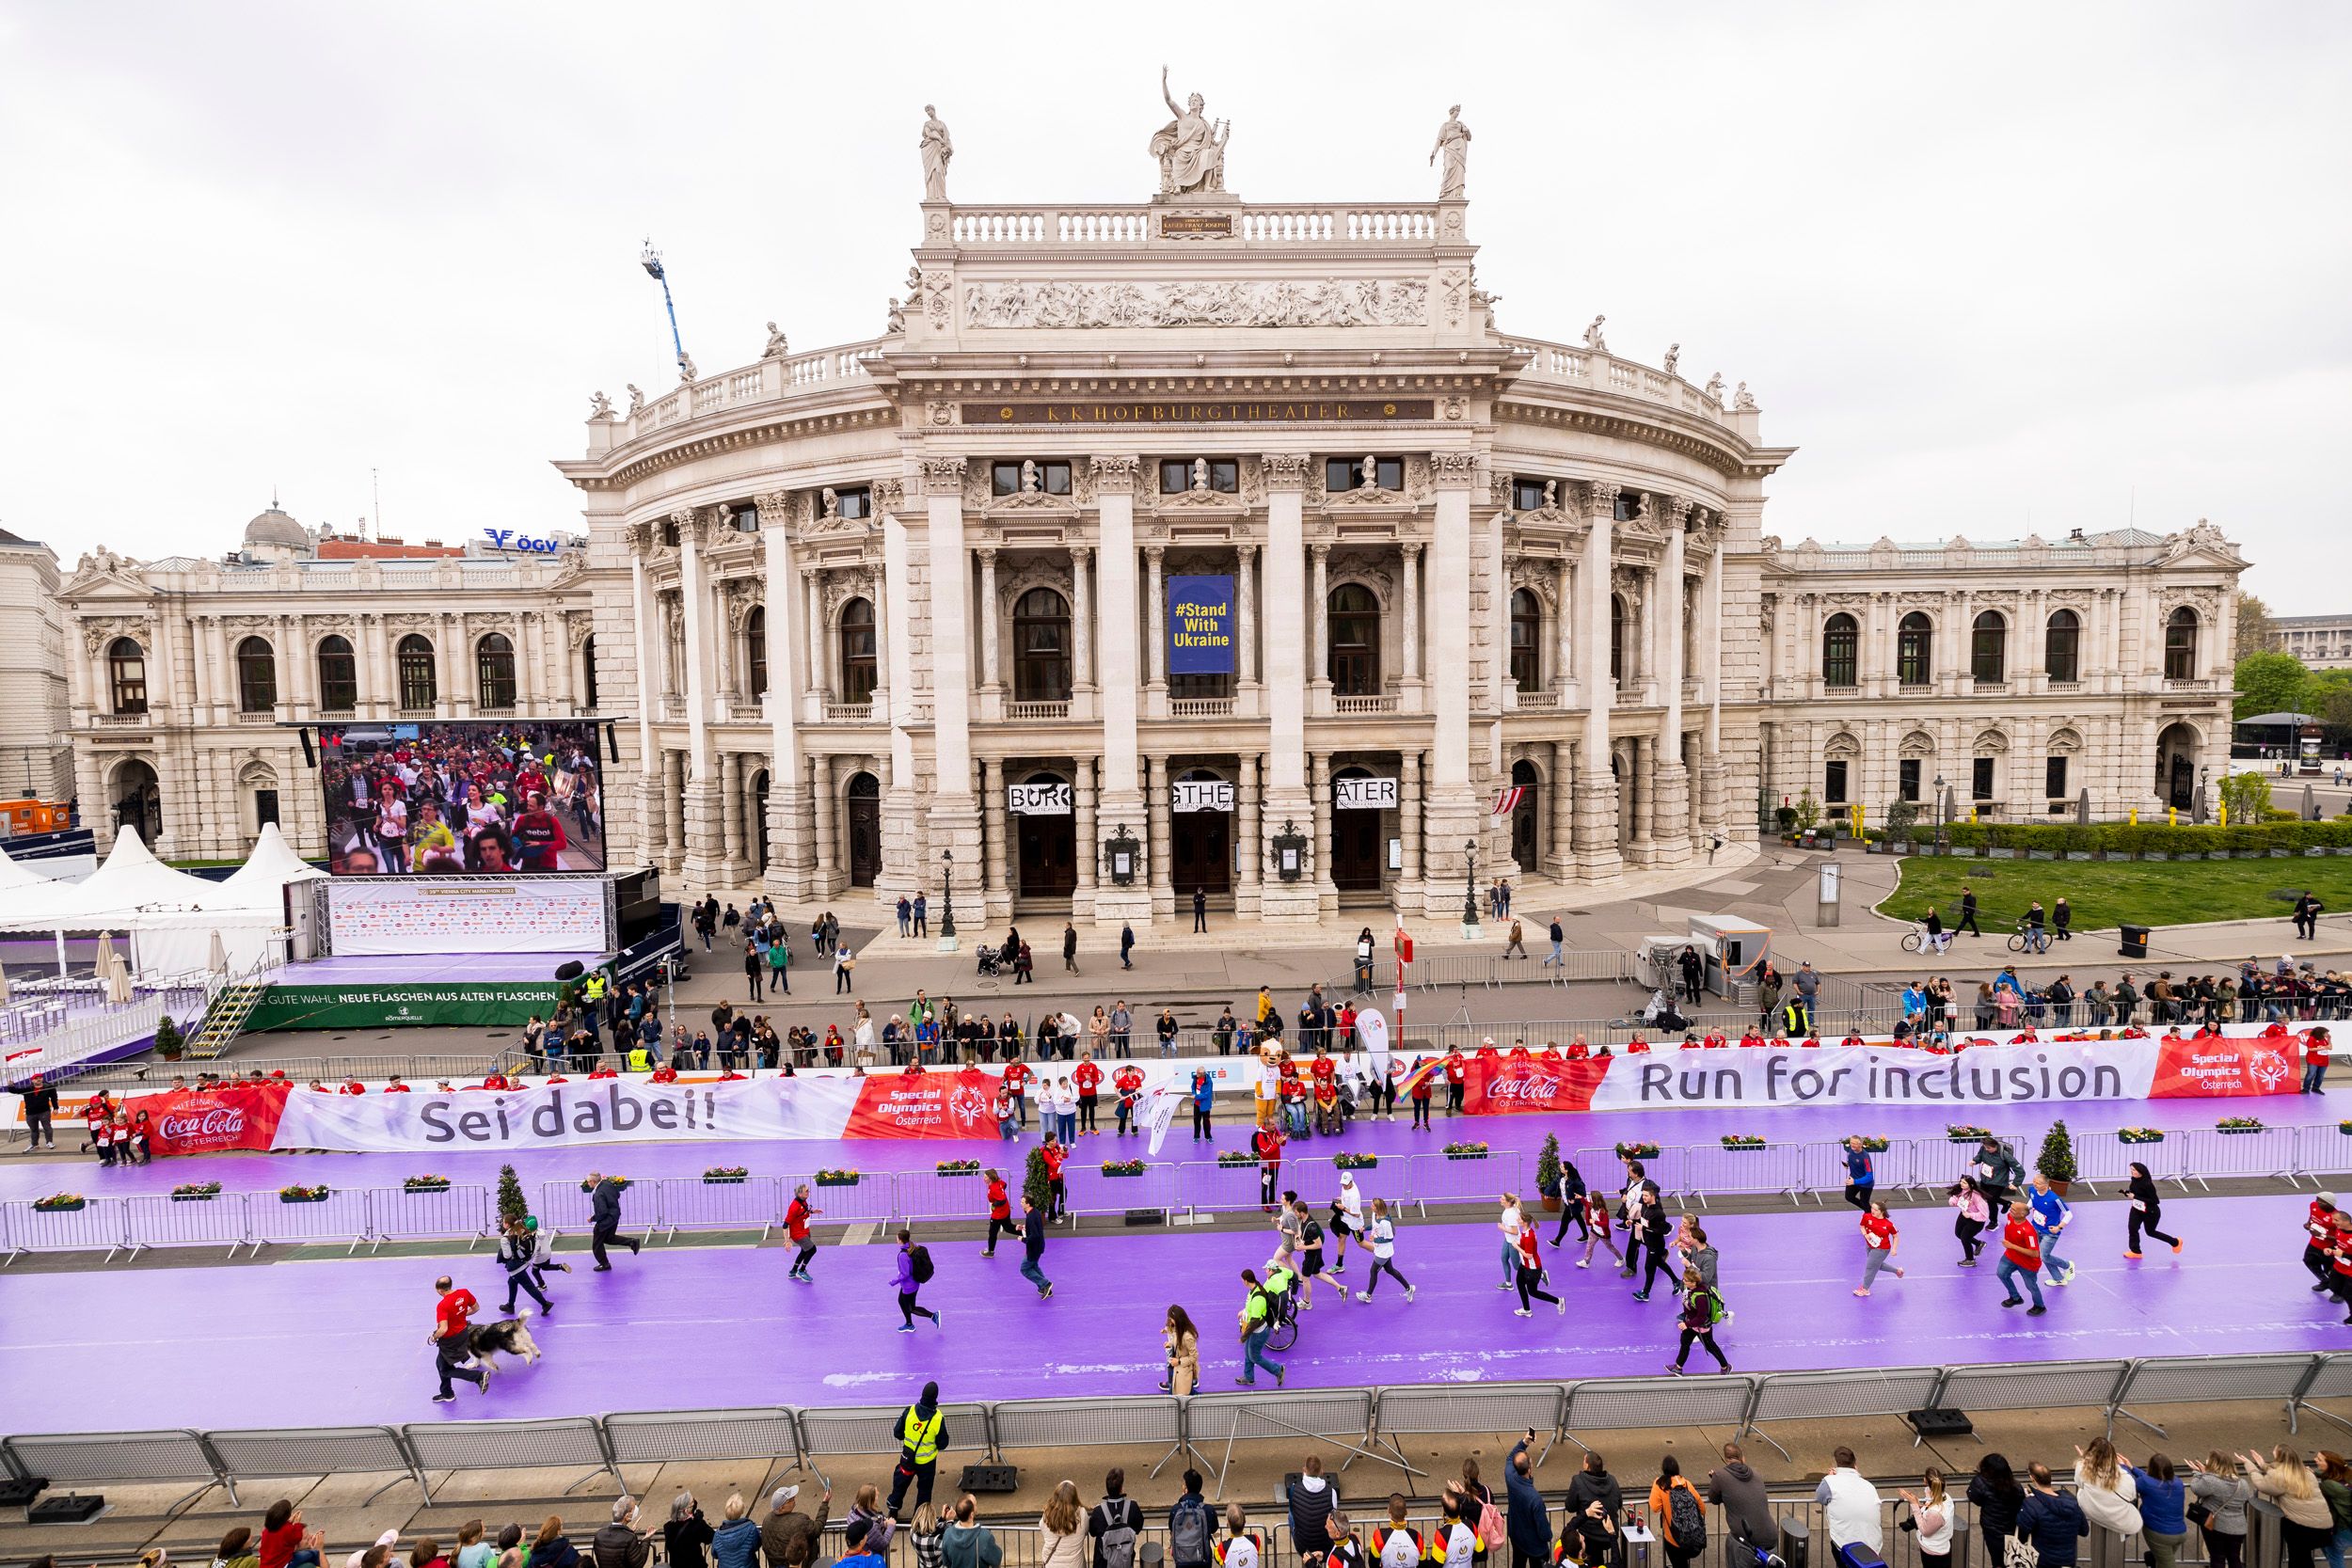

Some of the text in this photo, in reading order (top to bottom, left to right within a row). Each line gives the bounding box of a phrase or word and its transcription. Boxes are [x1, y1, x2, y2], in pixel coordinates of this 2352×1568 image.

[516, 534, 558, 552] ÖGV
[1175, 602, 1227, 617] #Stand
[1184, 618, 1218, 632] With
[1174, 632, 1230, 647] Ukraine
[1337, 782, 1394, 801] ATER
[268, 995, 298, 1006] GUTE
[299, 994, 337, 1005] WAHL:
[339, 993, 372, 1004] NEUE
[373, 992, 434, 1004] FLASCHEN
[436, 992, 458, 1002] AUS
[460, 991, 495, 1002] ALTEN
[497, 991, 559, 1002] FLASCHEN.
[2191, 1053, 2239, 1066] Special
[1641, 1053, 2122, 1101] Run for inclusion
[2180, 1067, 2241, 1079] Olympics
[2201, 1078, 2243, 1090] Österreich
[890, 1089, 941, 1101] Special
[172, 1098, 225, 1113] MITEINAND
[421, 1083, 716, 1143] Sei dabei!
[877, 1102, 941, 1115] Olympics
[159, 1107, 244, 1140] Coca-Cola
[895, 1114, 941, 1126] Österreich
[181, 1134, 239, 1148] ÖSTERREICH
